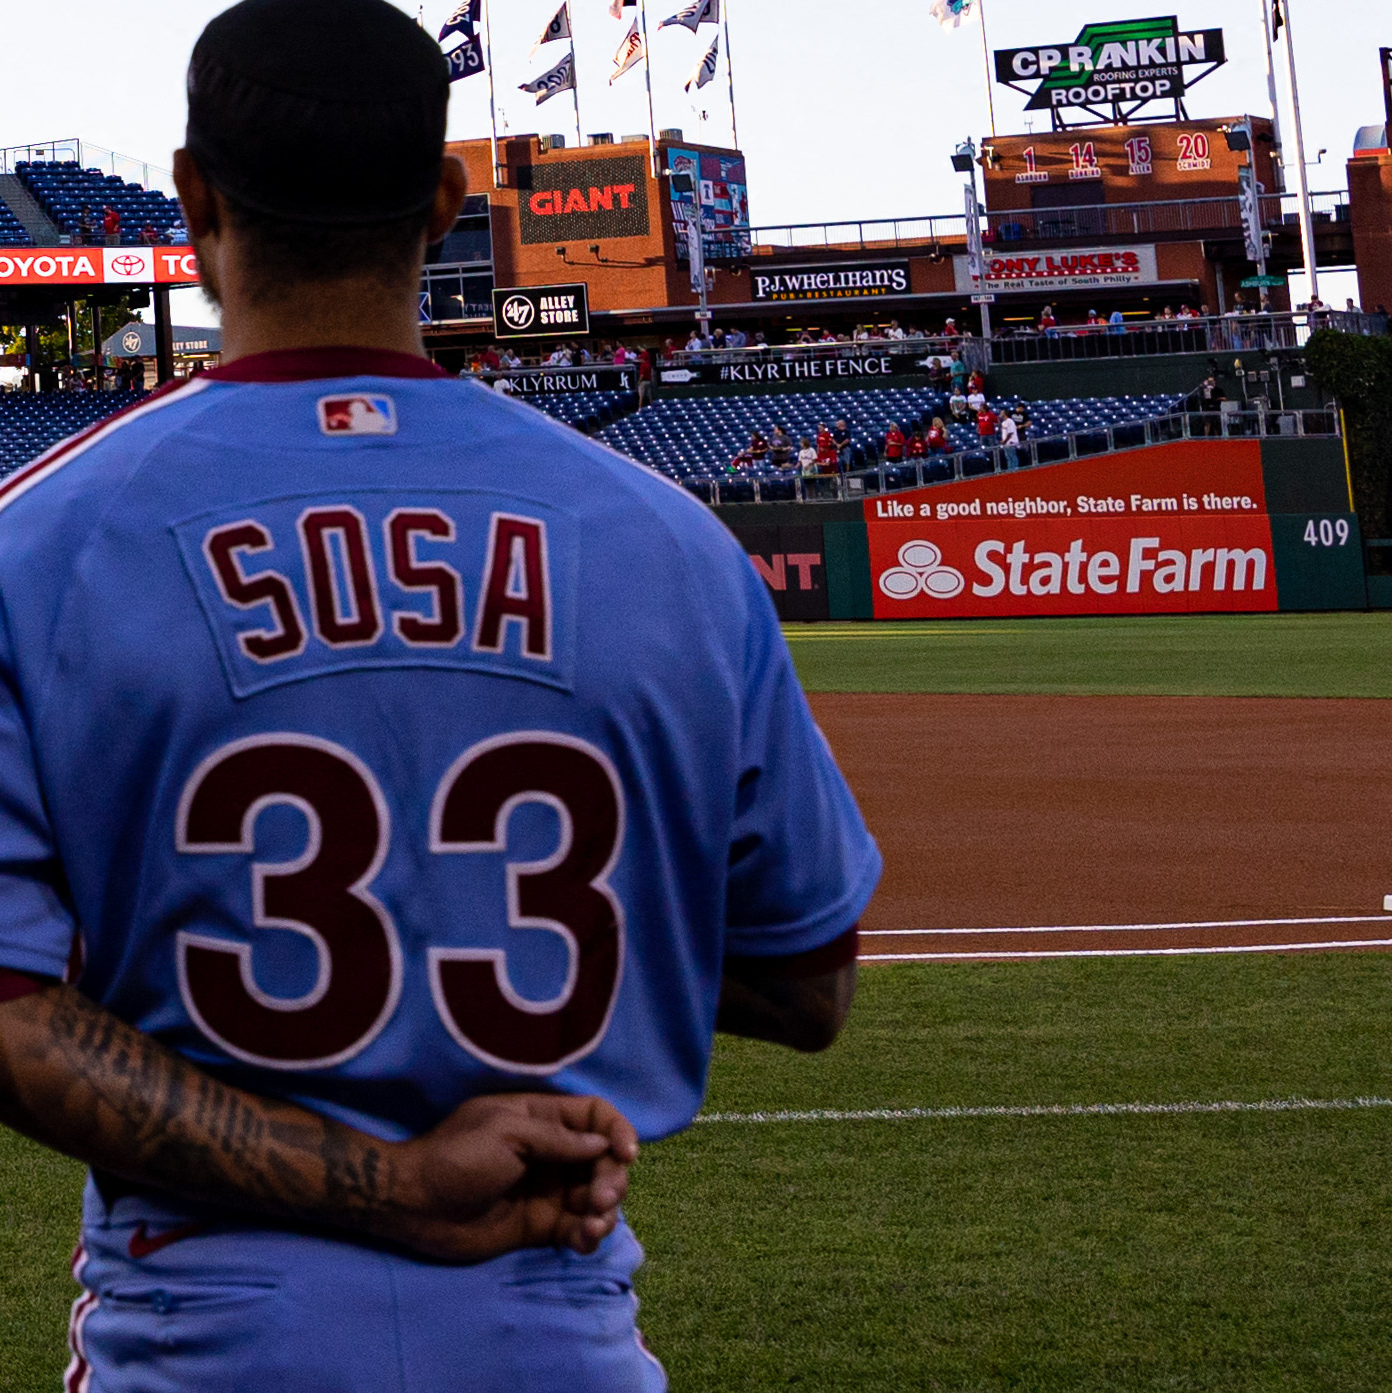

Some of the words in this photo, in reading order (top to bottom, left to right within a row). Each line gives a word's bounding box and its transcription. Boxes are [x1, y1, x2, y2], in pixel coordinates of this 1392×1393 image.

[1012, 48, 1062, 76] CP
[1068, 33, 1206, 73] RANKIN
[1093, 69, 1136, 83] ROOFING
[1138, 66, 1178, 78] EXPERTS
[1051, 78, 1172, 106] ROOFTOP
[1023, 146, 1036, 173] 1
[1069, 141, 1097, 170] 14
[1124, 136, 1152, 165] 15
[1176, 132, 1209, 160] 20
[528, 182, 636, 217] GIANT
[161, 254, 199, 276] TO
[990, 256, 1041, 273] ONY
[1044, 251, 1139, 270] LUKE'S
[772, 292, 796, 301] PUB
[806, 287, 887, 299] RESTAURANT
[1003, 280, 1025, 289] Real
[1029, 278, 1055, 287] Taste
[1058, 277, 1068, 286] of
[1071, 276, 1100, 285] South
[1103, 274, 1132, 285] Philly
[540, 294, 575, 311] ALLEY
[540, 309, 579, 325] STORE
[509, 373, 598, 393] KLYRRUM
[876, 500, 915, 518] Like
[919, 505, 931, 517] a
[936, 499, 983, 520] good
[985, 497, 1072, 518] neighbor,
[1076, 495, 1126, 513] State
[1130, 494, 1179, 512] Farm
[1182, 493, 1199, 511] is
[1202, 492, 1258, 511] there.
[1303, 518, 1350, 547] 409
[203, 505, 553, 665] SOSA
[748, 553, 822, 591] NT
[174, 730, 627, 1075] 33
